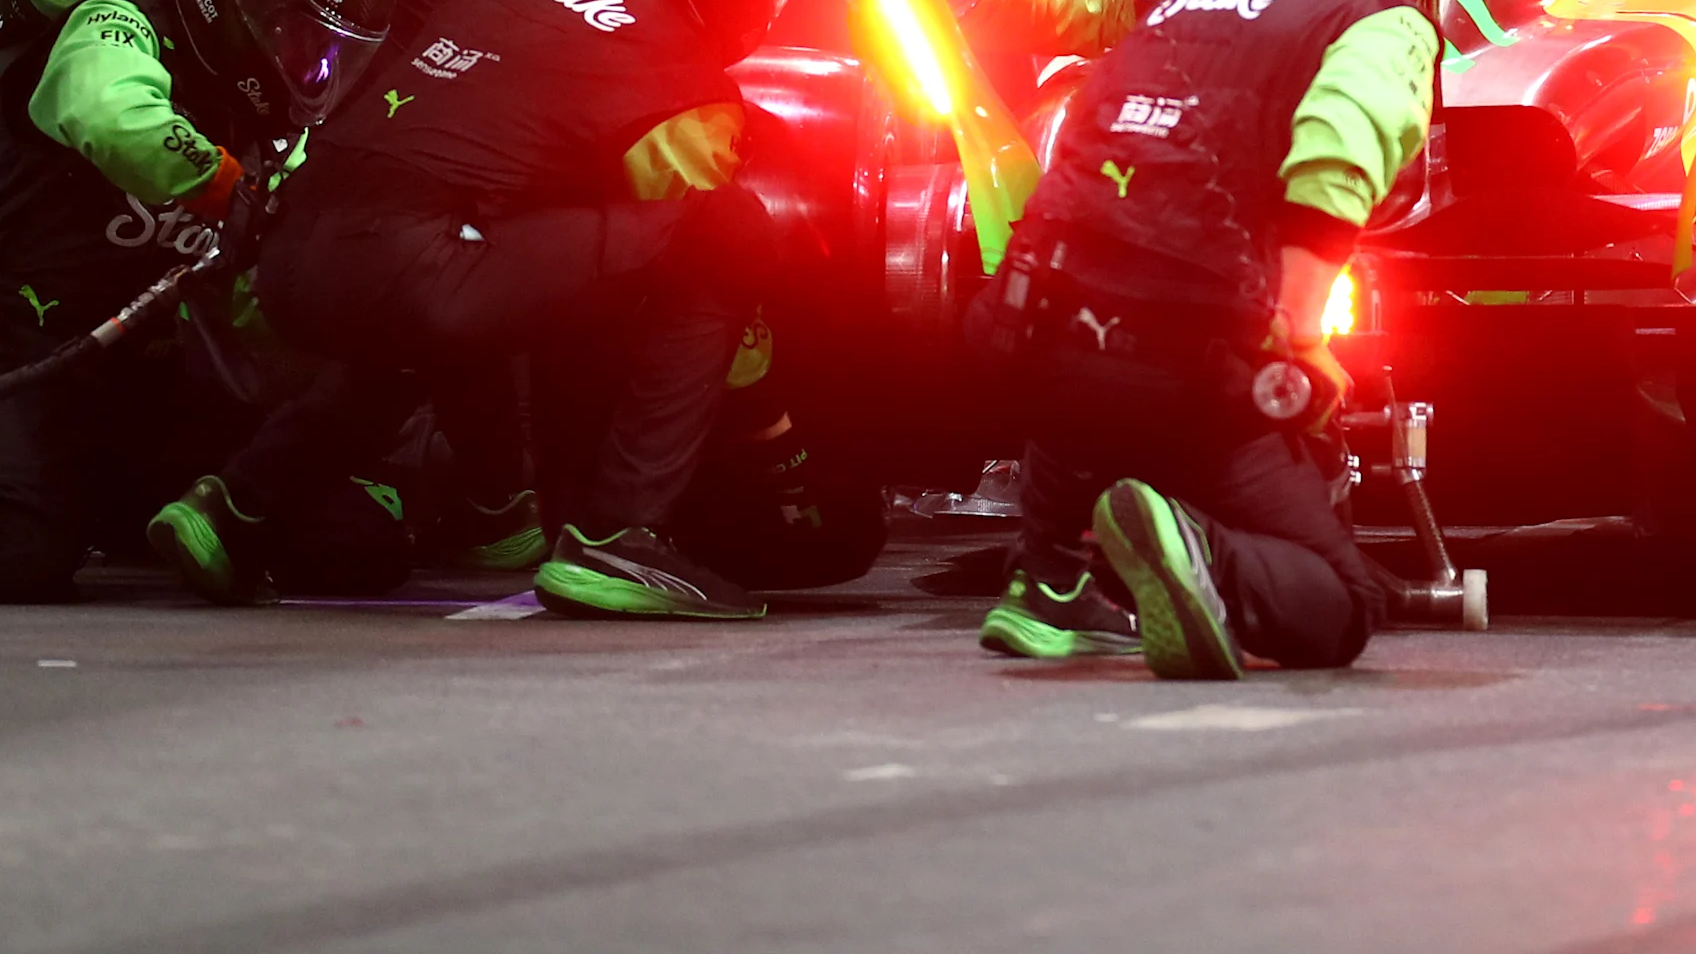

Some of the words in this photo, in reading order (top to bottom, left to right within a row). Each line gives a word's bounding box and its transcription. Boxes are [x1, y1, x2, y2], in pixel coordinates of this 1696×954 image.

[87, 9, 151, 39] Hyland
[100, 29, 135, 48] FIX
[237, 77, 271, 116] Stake
